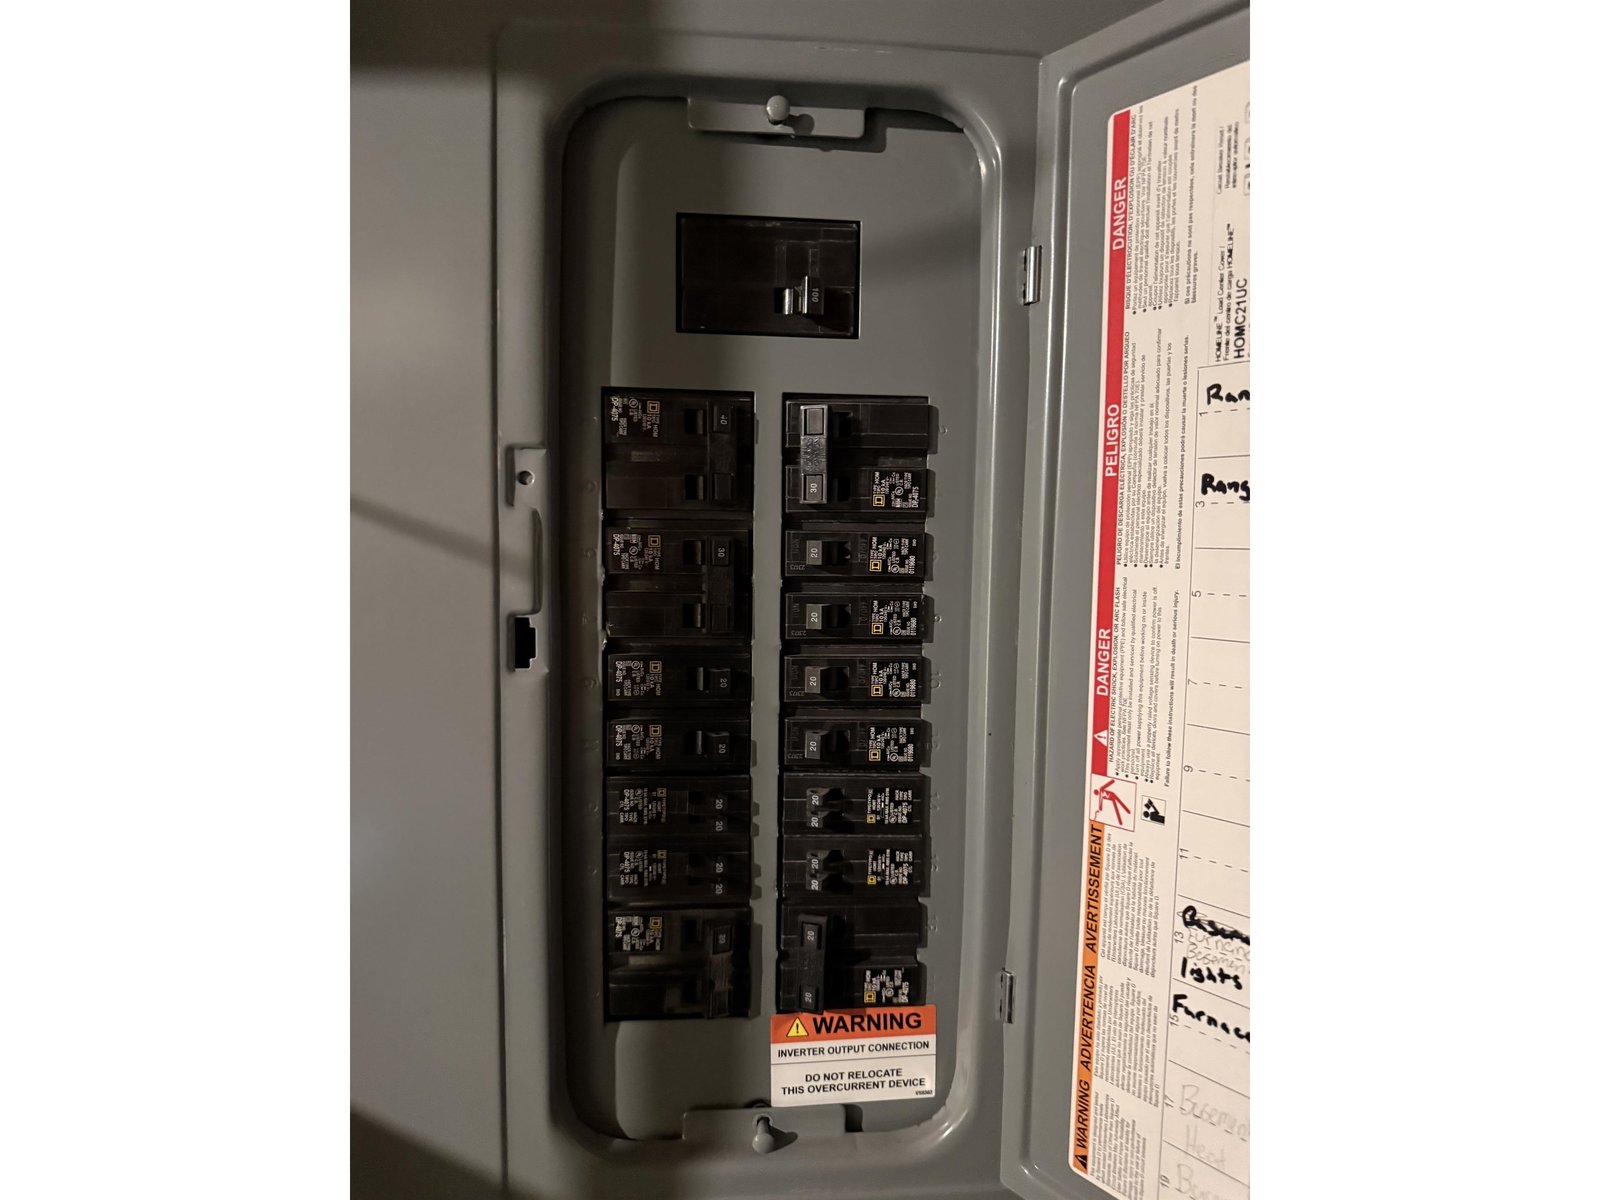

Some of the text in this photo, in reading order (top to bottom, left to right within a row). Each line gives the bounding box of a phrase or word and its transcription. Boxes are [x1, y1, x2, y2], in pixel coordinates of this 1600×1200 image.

[1112, 177, 1127, 250] DANGER
[1234, 278, 1248, 359] HOMC21UC
[611, 397, 619, 422] DP-4075
[720, 414, 728, 425] 40
[1104, 404, 1120, 477] PELIGRO
[1178, 454, 1186, 492] precauciones
[810, 483, 818, 493] 30
[911, 487, 919, 508] DP-4075
[1177, 510, 1183, 518] de
[1118, 528, 1123, 536] DE
[612, 533, 620, 556] DP-4075
[1175, 518, 1183, 562] incumplimiento
[718, 548, 725, 558] 30
[811, 548, 818, 558] 20
[1191, 590, 1202, 598] 5
[811, 613, 818, 623] 20
[1096, 628, 1111, 696] DANGER
[720, 678, 728, 688] 20
[810, 676, 817, 687] 20
[1109, 728, 1115, 736] OF
[1113, 624, 1119, 633] OR
[1188, 678, 1198, 686] 7
[1167, 691, 1175, 725] instructions
[719, 743, 726, 754] 20
[810, 741, 817, 752] 20
[1183, 764, 1194, 773] 9
[715, 799, 723, 810] 20
[812, 795, 820, 806] 20
[715, 821, 723, 831] 20
[811, 817, 819, 828] 20
[1179, 848, 1189, 860] 11
[715, 863, 724, 873] 20
[812, 859, 819, 870] 20
[715, 884, 723, 895] 20
[811, 880, 819, 891] 20
[807, 930, 815, 941] 20
[1174, 931, 1183, 944] 13
[1076, 823, 1102, 1150] WARNING ADVERTENCIA AVERTISSEMENT
[805, 992, 812, 1003] 20
[813, 1012, 922, 1034] WARNING
[1169, 1014, 1180, 1028] 15
[778, 1041, 930, 1058] INVERTER OUTPUT CONNECTION
[805, 1068, 903, 1082] DO NOT RELOCATE
[782, 1078, 926, 1095] THIS OVERCURRENT DEVICE
[1160, 1174, 1170, 1188] 19
